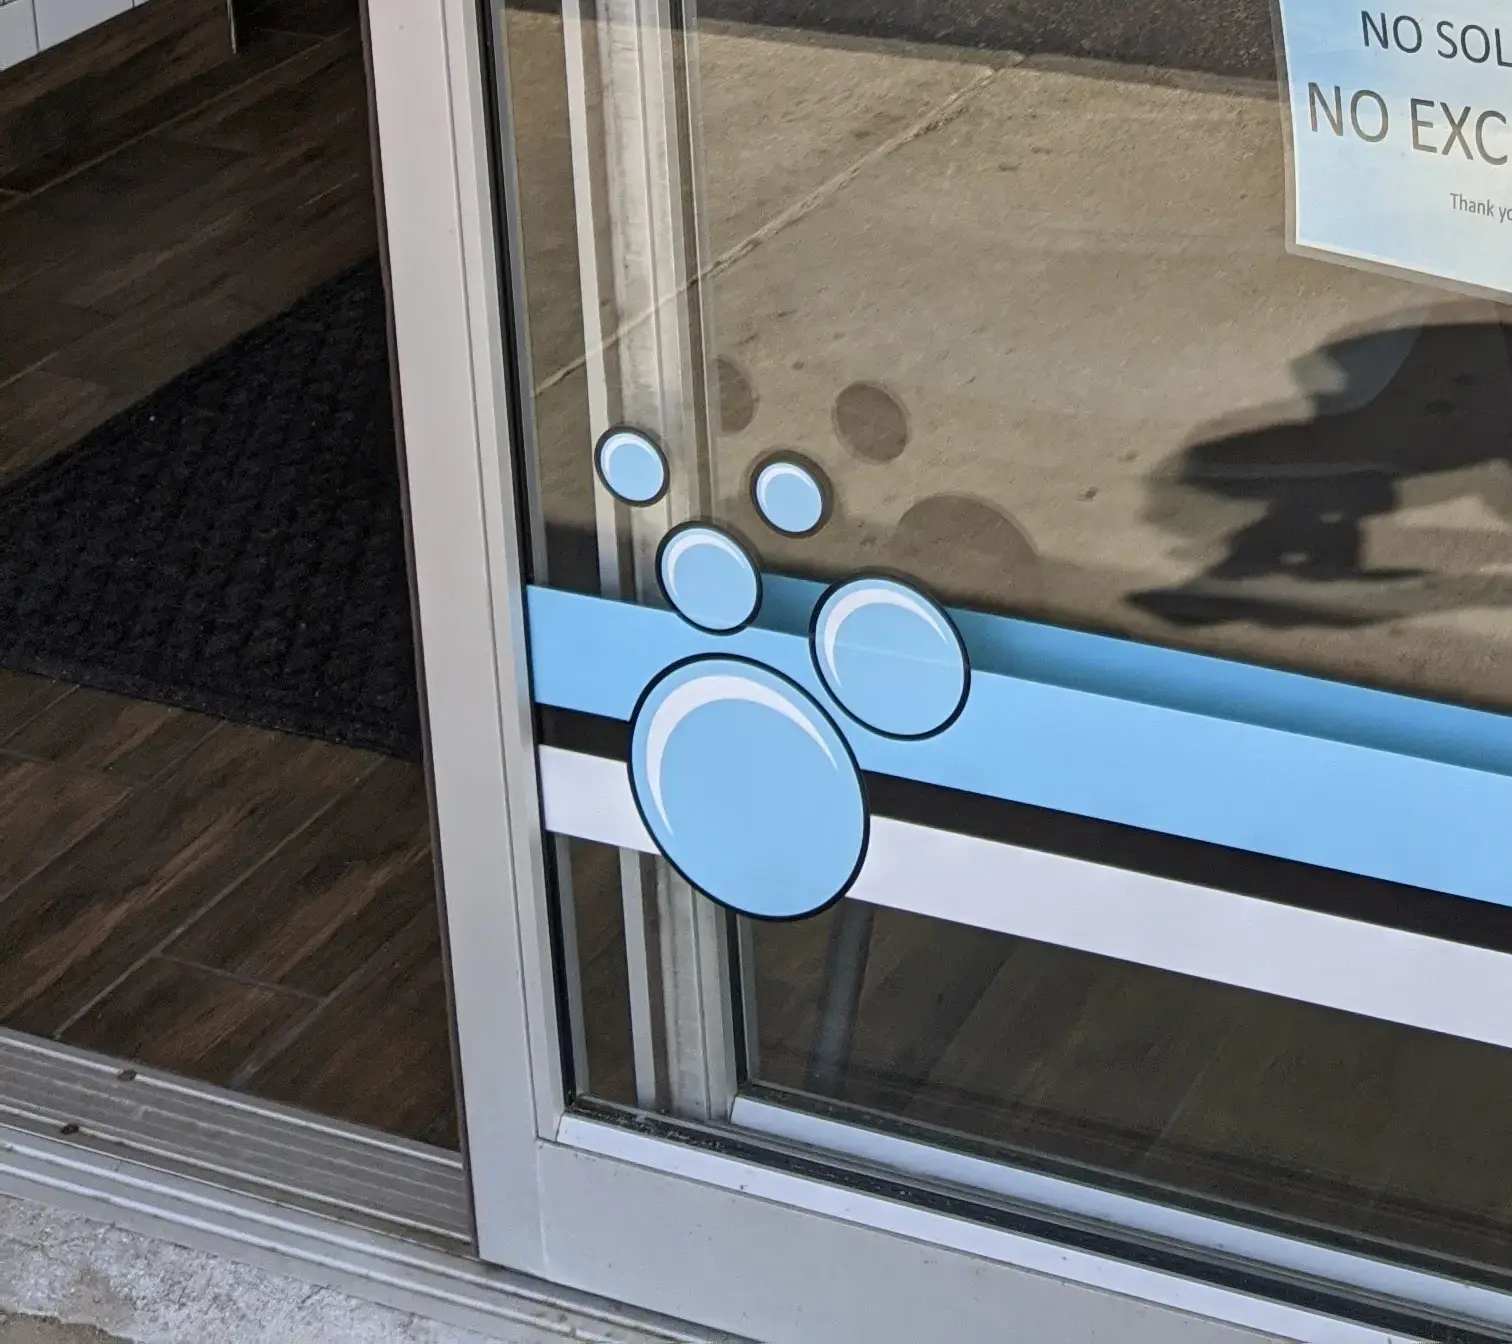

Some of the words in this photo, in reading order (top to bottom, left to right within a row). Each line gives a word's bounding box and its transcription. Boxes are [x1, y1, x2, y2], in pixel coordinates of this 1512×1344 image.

[1361, 10, 1423, 54] NO
[1307, 81, 1390, 143] NO
[1449, 191, 1495, 218] Thank
